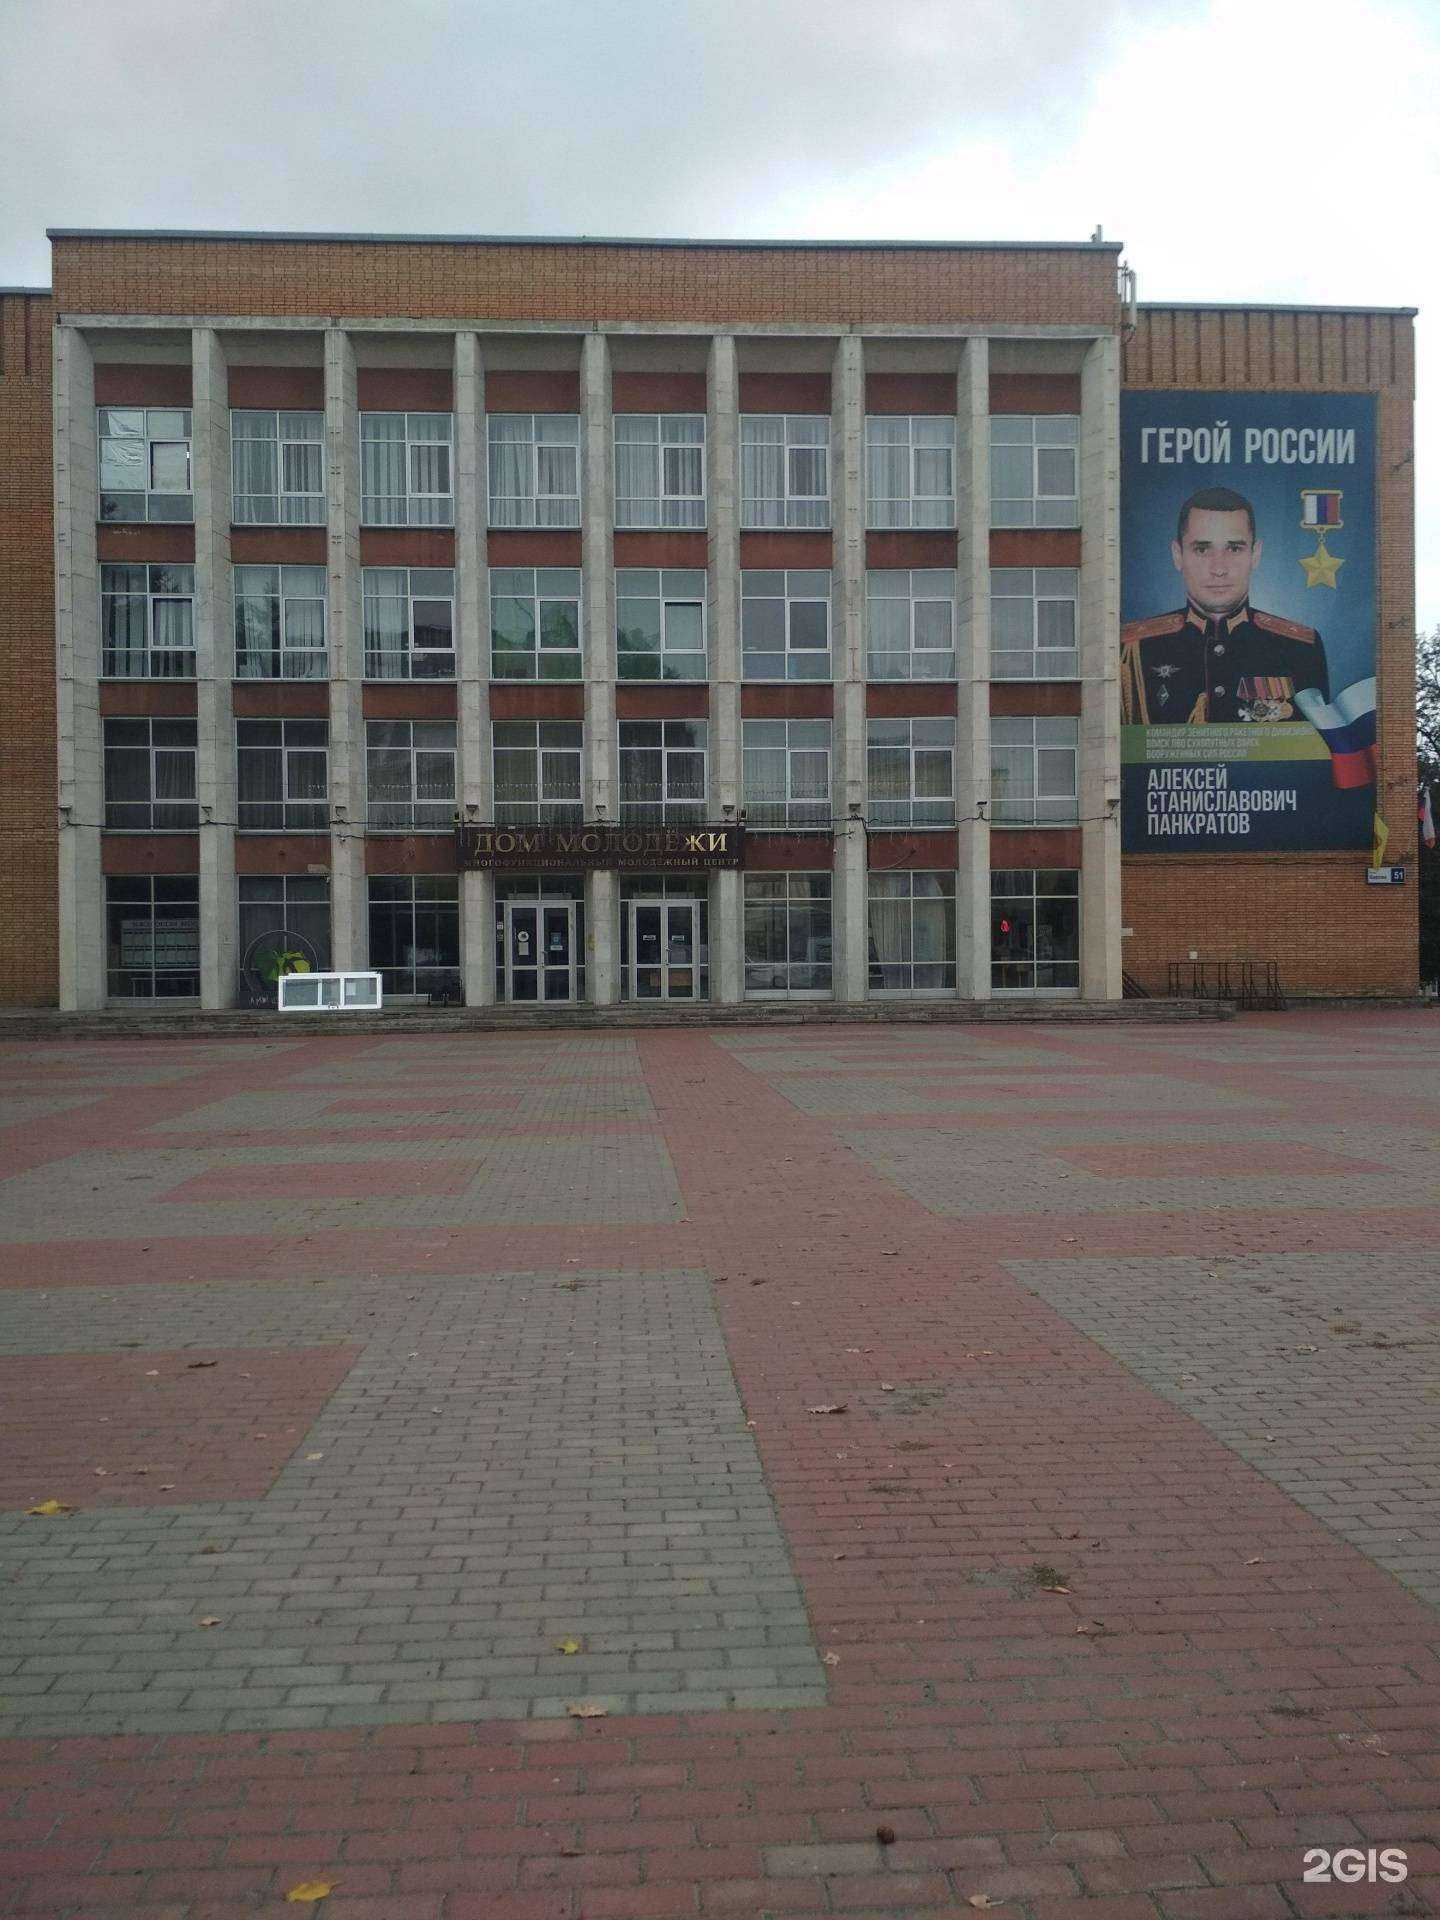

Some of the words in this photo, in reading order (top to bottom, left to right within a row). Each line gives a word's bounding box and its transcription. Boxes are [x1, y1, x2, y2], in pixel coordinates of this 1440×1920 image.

[1141, 420, 1231, 464] ГЕРОЙ
[1244, 428, 1355, 464] РОССИИ
[1148, 763, 1228, 790] АЛЕКСЕЙ
[1147, 790, 1297, 813] СТАНИСЛАВОВИЧ
[1148, 813, 1250, 835] ПАНКРАТОВ
[475, 833, 543, 856] ДОМ
[1393, 871, 1404, 880] 51
